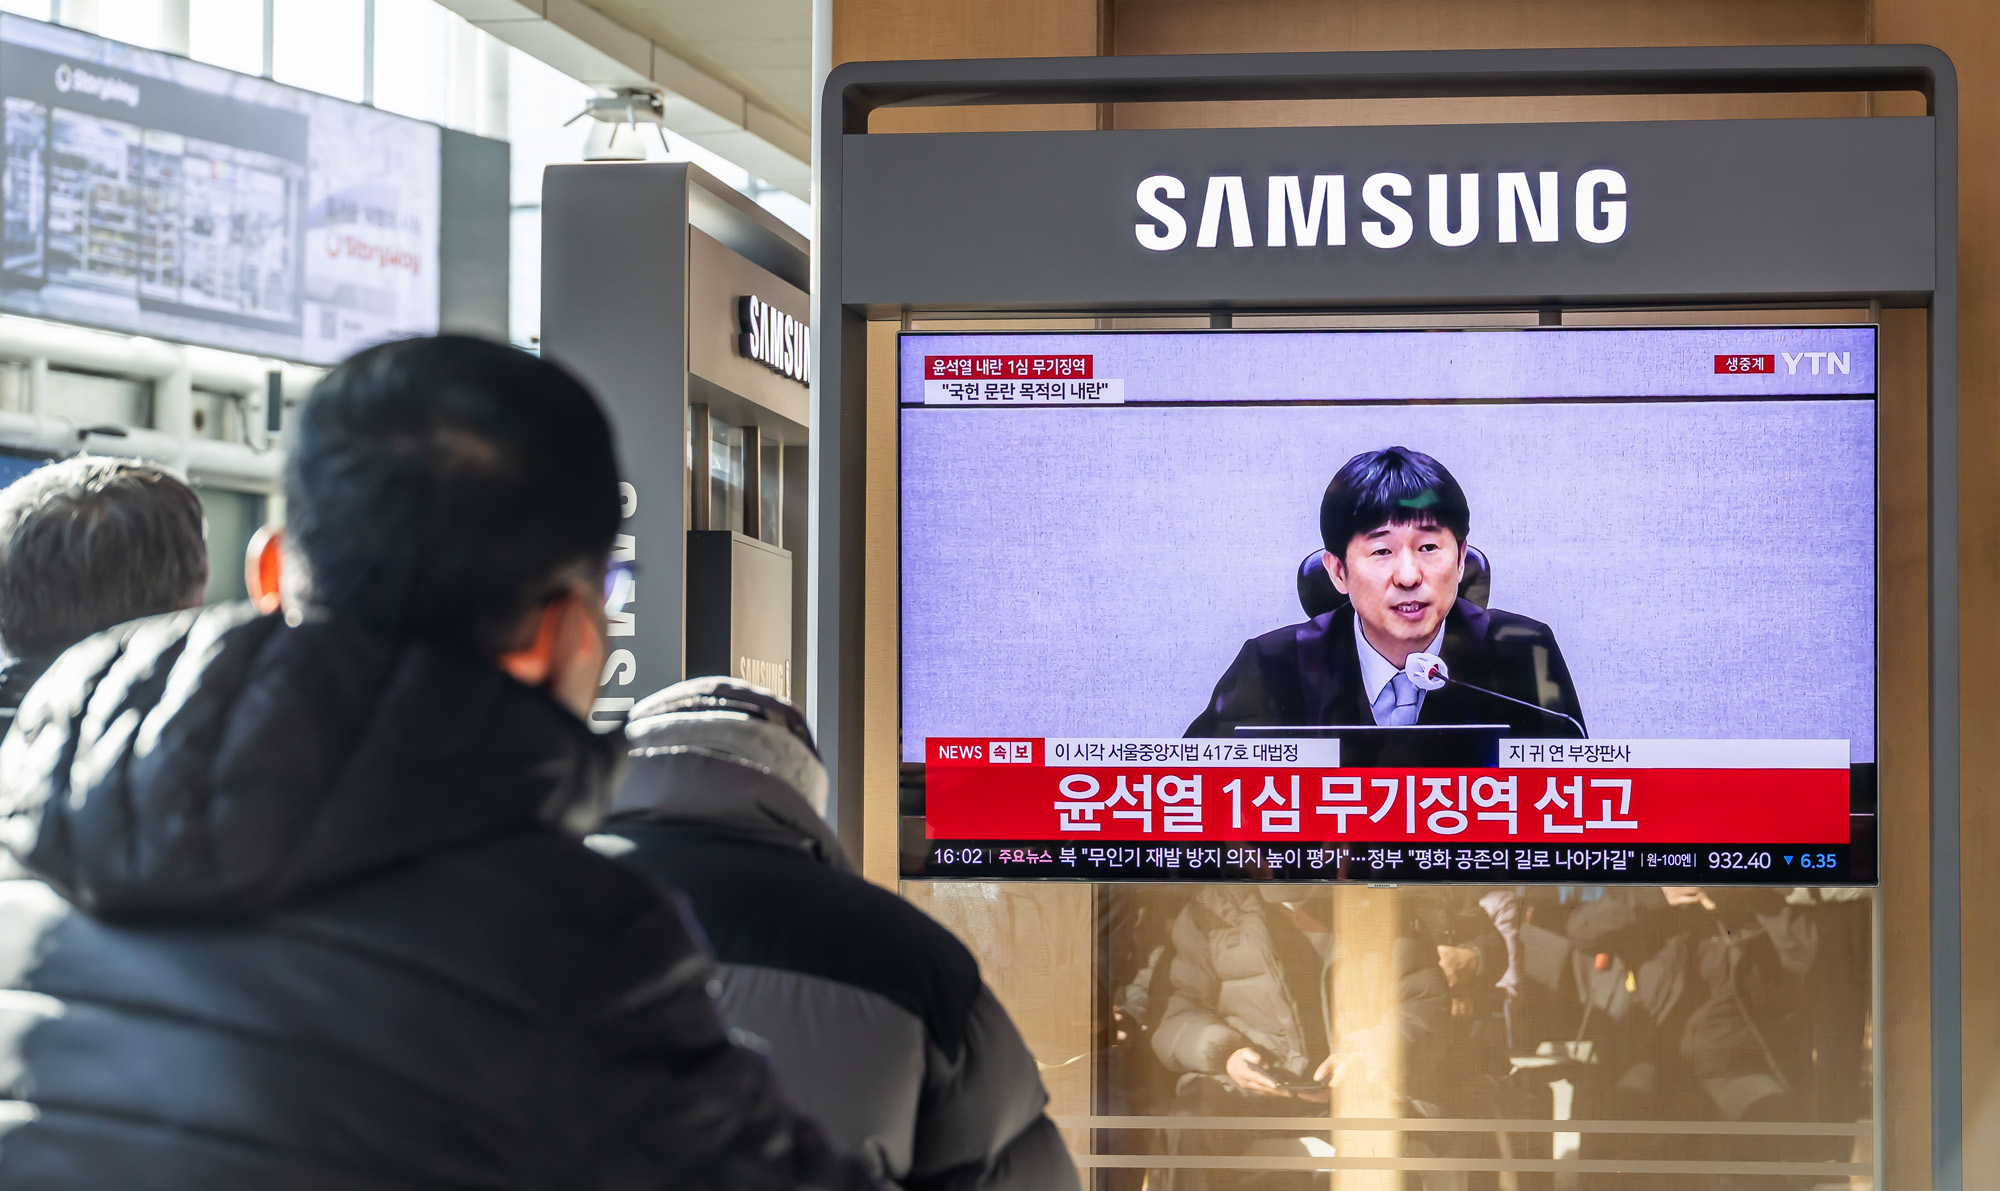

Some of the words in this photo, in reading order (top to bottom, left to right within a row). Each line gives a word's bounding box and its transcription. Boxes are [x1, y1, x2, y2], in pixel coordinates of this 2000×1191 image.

[1135, 169, 1627, 251] SAMSUNG
[932, 358, 972, 376] 윤석열
[976, 358, 1003, 376] 내란
[1007, 358, 1028, 376] 1심
[1032, 358, 1085, 376] 무기징역
[1725, 356, 1764, 372] 생중계
[1780, 351, 1851, 375] YTN
[942, 382, 980, 401] "국헌
[984, 382, 1016, 401] 문란
[1019, 382, 1066, 401] 목적의
[1070, 381, 1109, 400] 내란"
[740, 656, 784, 697] SAMSUNG
[939, 745, 983, 760] NEWS
[1055, 743, 1070, 761] 이
[1074, 743, 1106, 762] 시각
[1107, 743, 1199, 762] 서울중앙지법
[1203, 744, 1249, 761] 417호
[1253, 743, 1298, 762] 대법정
[1567, 744, 1632, 763] 부장판사
[1053, 773, 1204, 834] 윤석열
[1222, 774, 1300, 834] 1심
[1315, 775, 1518, 836] 무기징역
[1533, 775, 1639, 835] 선고
[934, 848, 983, 865] 16:02
[998, 849, 1053, 865] 주요뉴스
[1058, 847, 1078, 868] 북
[1081, 847, 1141, 868] "무인기
[1145, 847, 1183, 869] 재발
[1186, 847, 1221, 869] 방지
[1225, 847, 1261, 869] 의지
[1265, 848, 1301, 869] 높이
[1408, 848, 1452, 870] "평화
[1454, 848, 1509, 870] 공존의
[1514, 848, 1551, 870] 길로
[1555, 849, 1635, 871] 나아가길"
[1708, 851, 1772, 870] 932.40
[1800, 853, 1838, 870] 6.35
